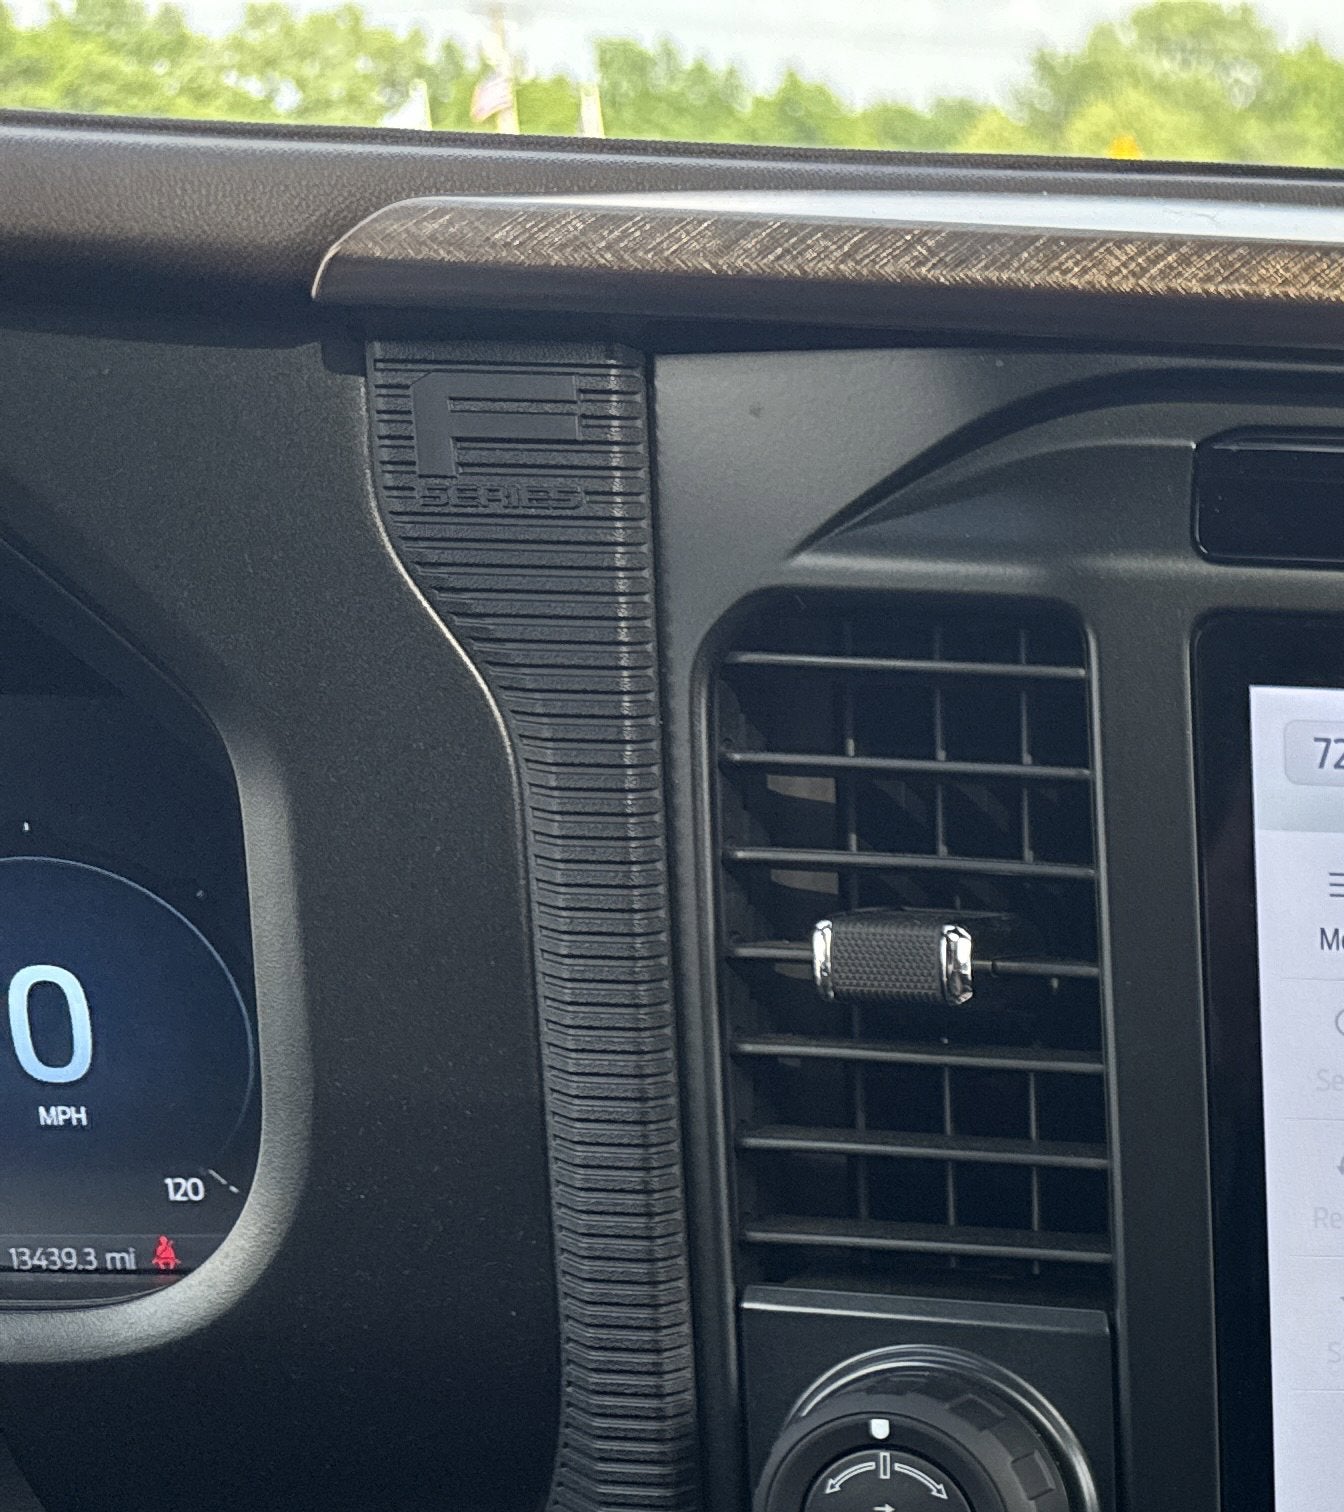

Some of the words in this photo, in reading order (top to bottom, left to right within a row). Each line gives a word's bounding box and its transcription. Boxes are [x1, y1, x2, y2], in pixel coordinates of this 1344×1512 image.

[7, 963, 94, 1084] 0
[38, 1105, 88, 1128] MPH
[164, 1177, 206, 1202] 120
[8, 1247, 98, 1271] 13439.3
[105, 1246, 137, 1271] mi
